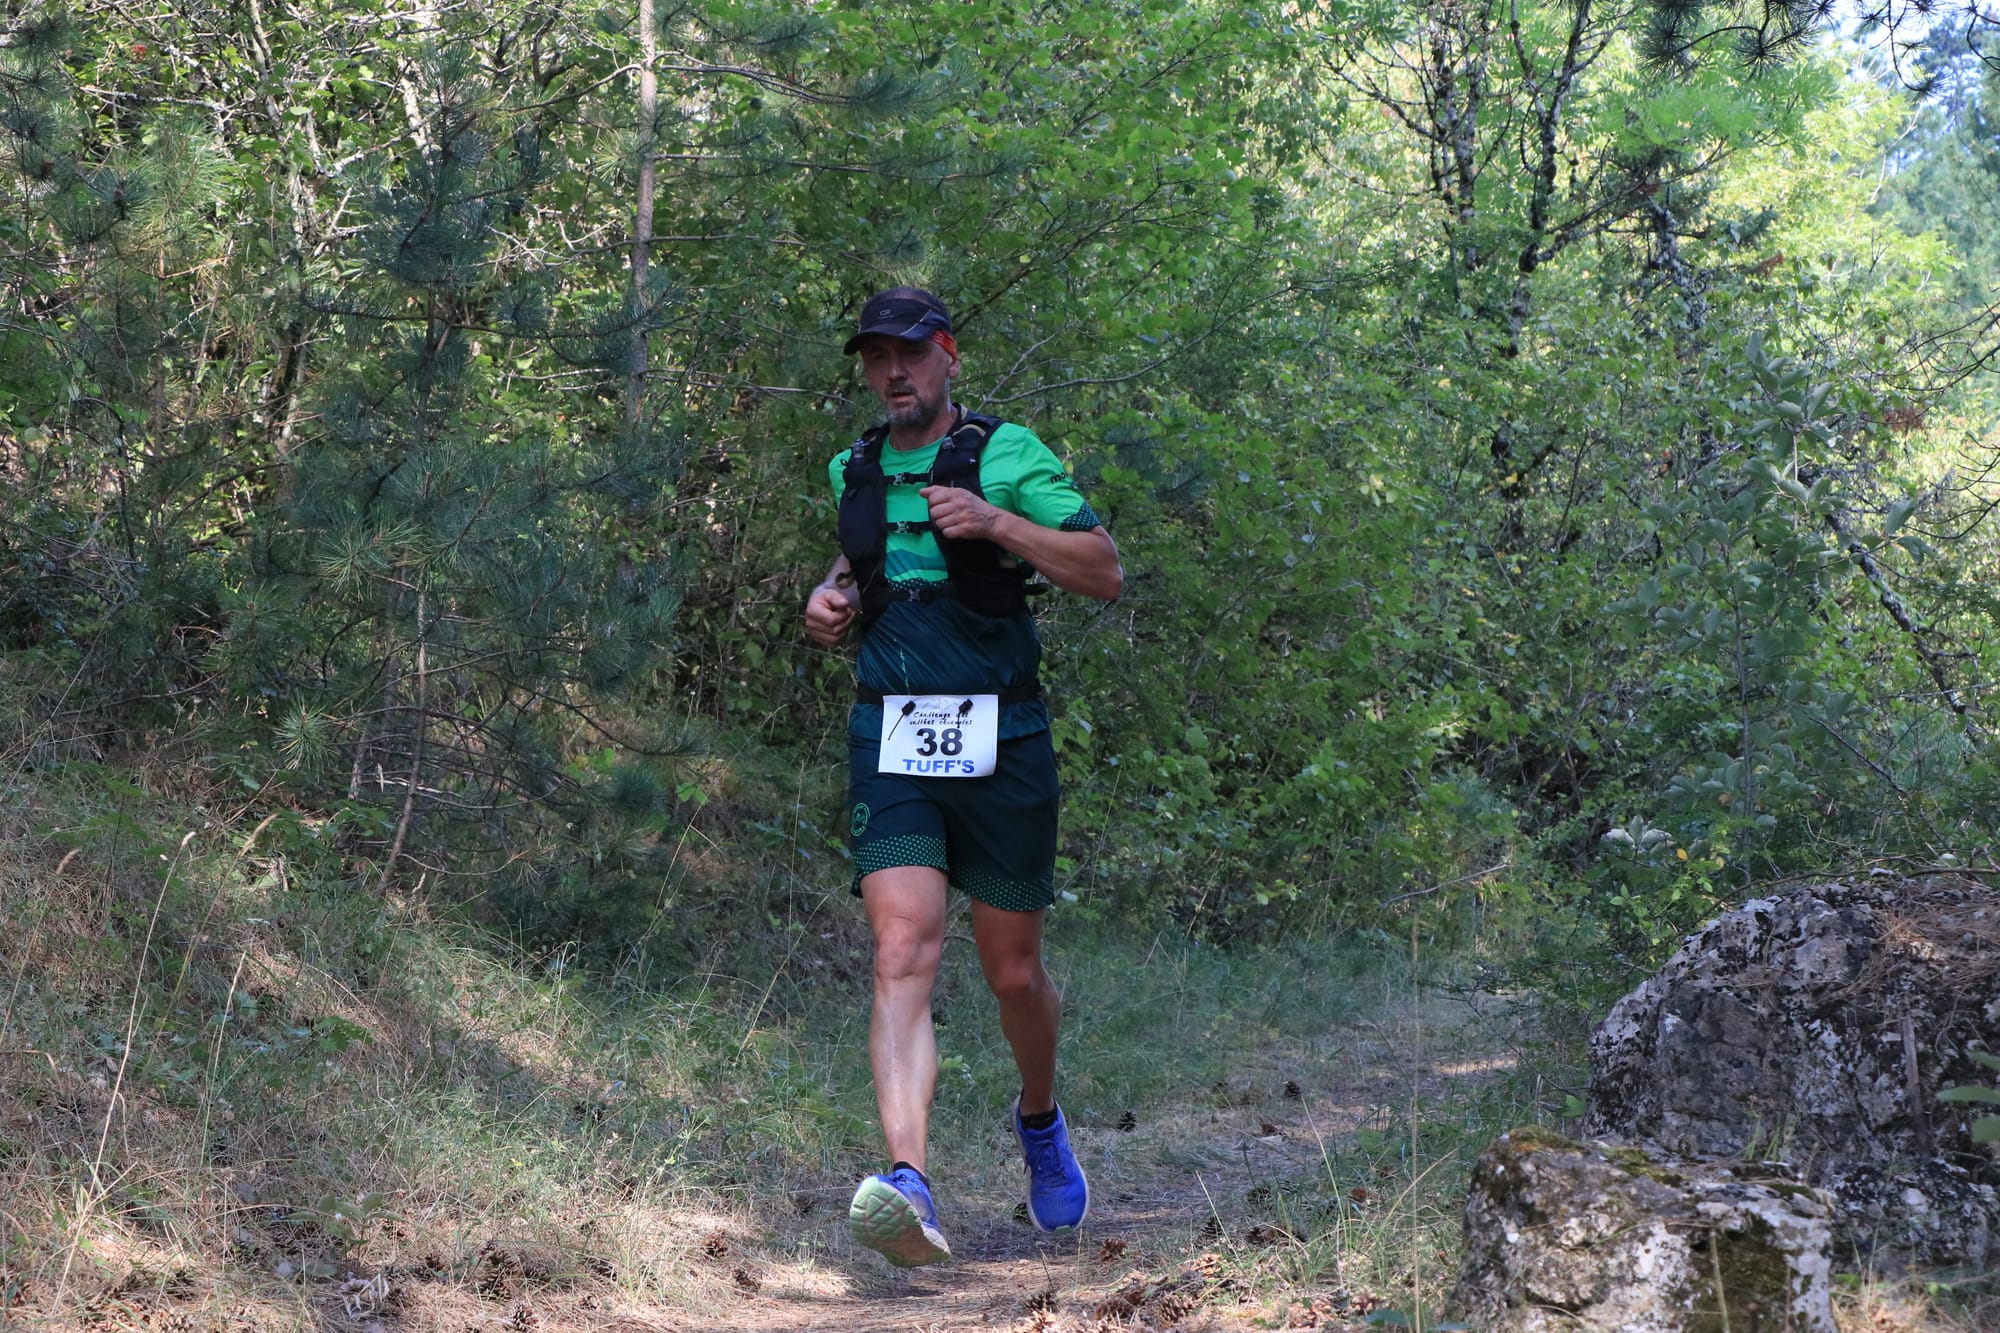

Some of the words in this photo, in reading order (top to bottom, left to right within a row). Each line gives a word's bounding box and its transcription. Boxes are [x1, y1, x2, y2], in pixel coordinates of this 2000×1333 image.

[913, 711, 951, 721] Challenge
[916, 728, 963, 757] 38
[902, 759, 975, 774] TUFF'S
